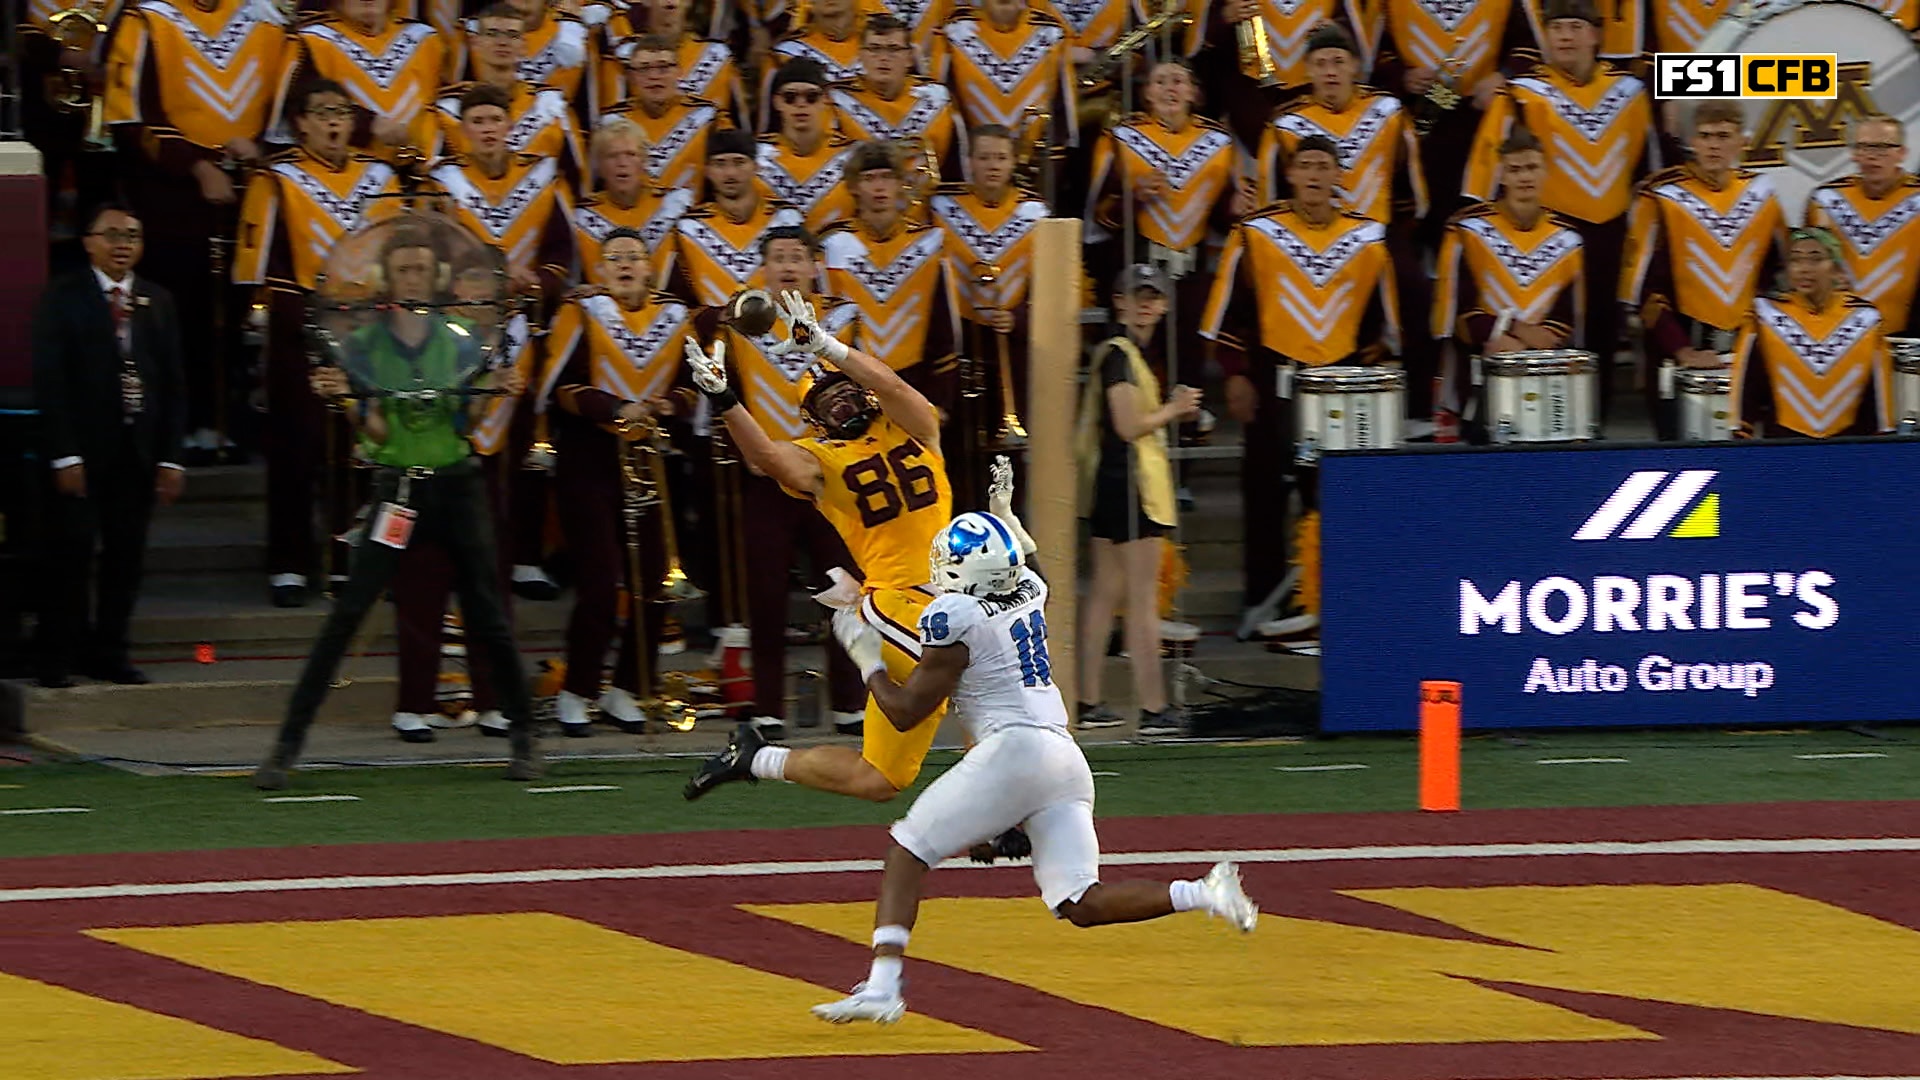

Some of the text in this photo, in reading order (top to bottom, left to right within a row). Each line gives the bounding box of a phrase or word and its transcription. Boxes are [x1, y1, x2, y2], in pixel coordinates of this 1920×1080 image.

[841, 437, 939, 529] 86
[921, 611, 950, 643] 18
[1459, 570, 1840, 635] MORRIE'S
[1522, 655, 1775, 697] Auto Group
